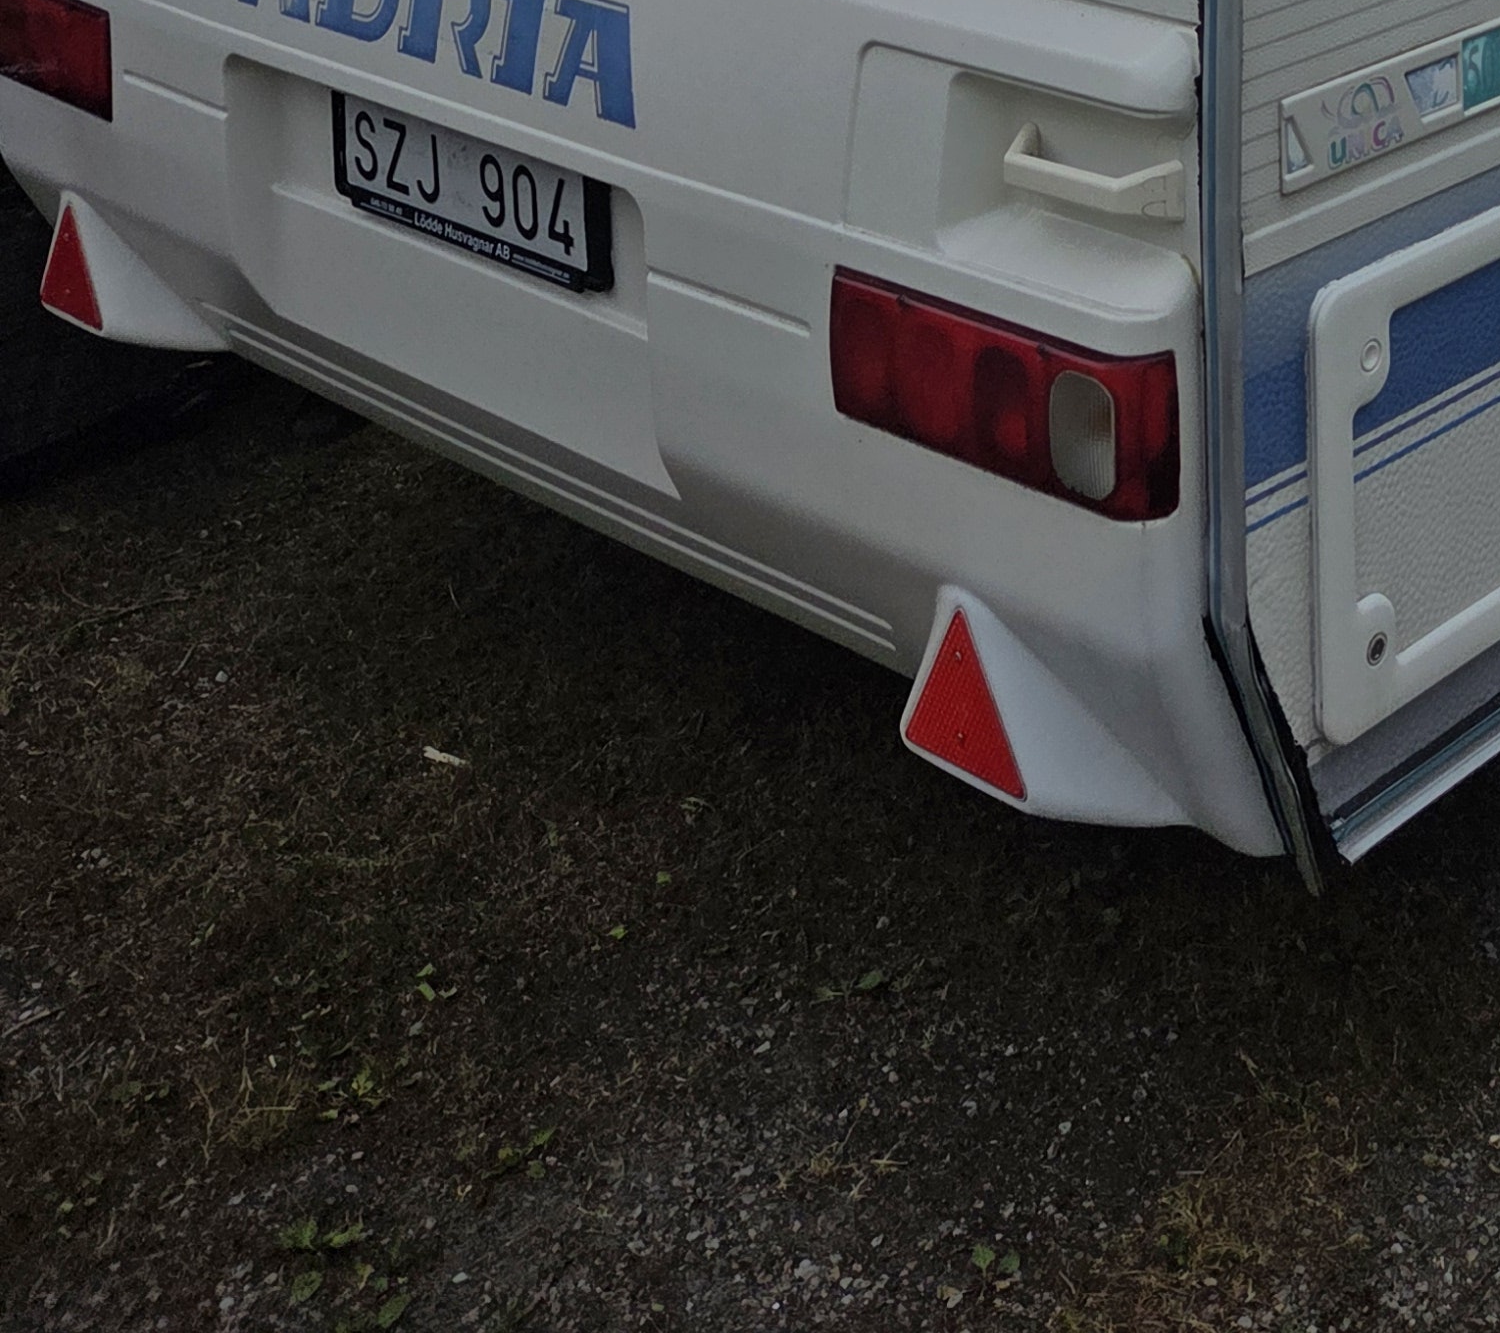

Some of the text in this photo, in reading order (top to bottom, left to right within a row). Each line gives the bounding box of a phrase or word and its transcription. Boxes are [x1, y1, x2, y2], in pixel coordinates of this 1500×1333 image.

[1327, 116, 1404, 170] UNCA
[353, 111, 575, 256] SZJ 904
[414, 211, 510, 261] Lödde Husvagnar AB
